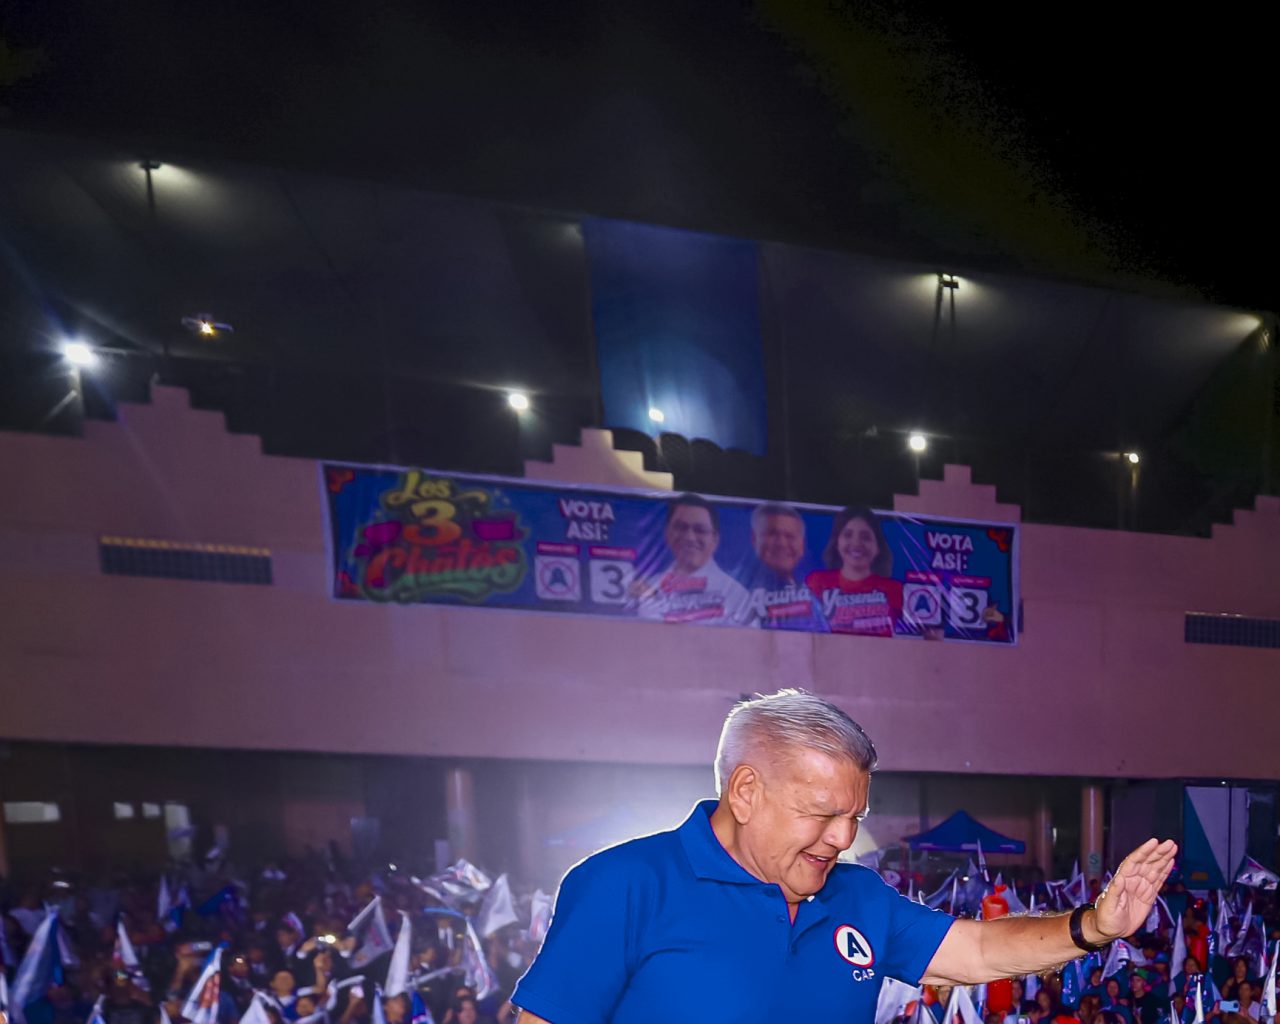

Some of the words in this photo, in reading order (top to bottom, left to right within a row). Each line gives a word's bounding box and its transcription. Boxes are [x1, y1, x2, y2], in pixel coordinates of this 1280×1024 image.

[403, 500, 462, 545] 3
[560, 498, 615, 521] VOTA
[926, 530, 974, 552] VOTA
[600, 565, 625, 599] 3
[959, 592, 980, 623] 3
[852, 969, 875, 981] CAP
